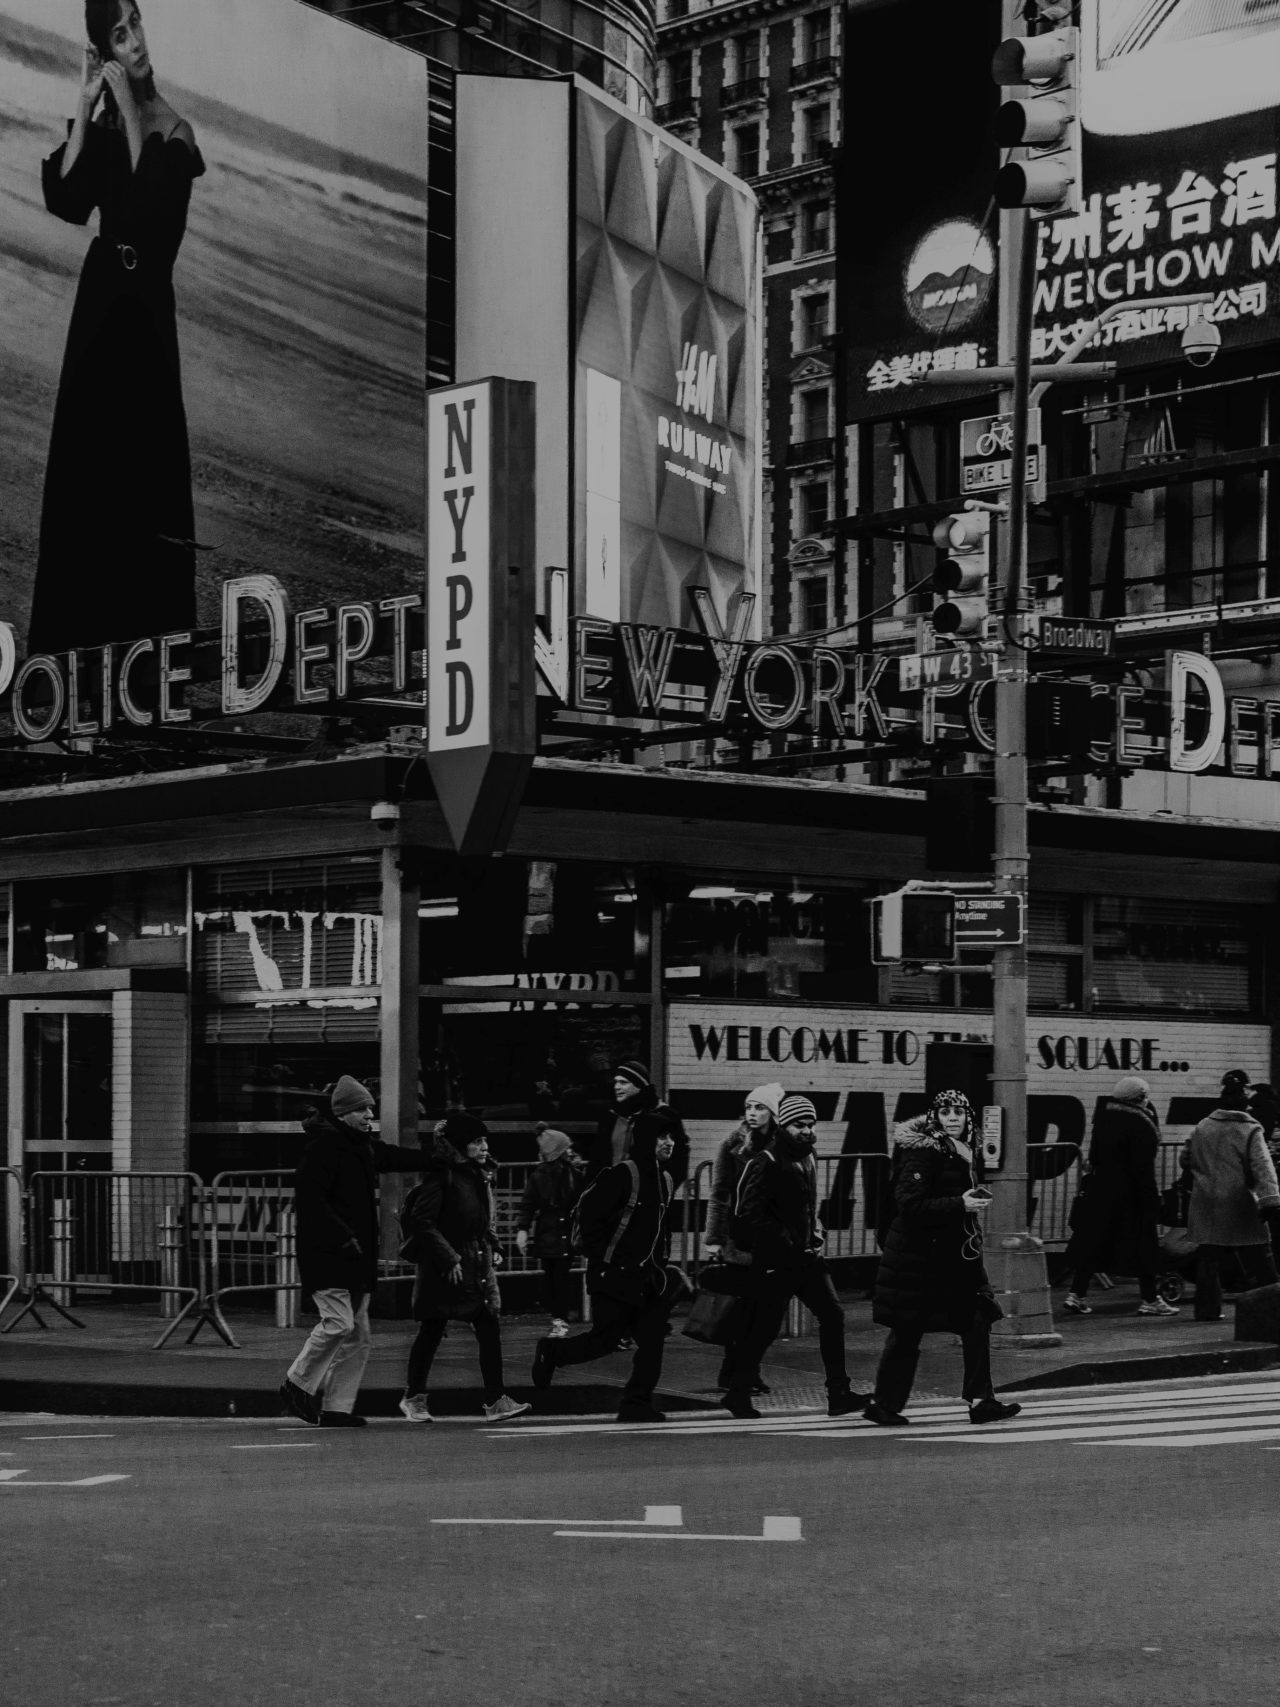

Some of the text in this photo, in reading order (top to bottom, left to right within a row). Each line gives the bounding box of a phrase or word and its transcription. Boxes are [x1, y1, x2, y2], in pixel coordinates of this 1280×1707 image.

[1033, 240, 1230, 314] WEICHOW
[657, 415, 732, 474] RUNWAY
[966, 457, 1038, 486] BIKE LE
[444, 399, 476, 737] NYPD
[1043, 622, 1112, 655] Broadway
[923, 656, 941, 683] W
[950, 653, 972, 679] 43
[1170, 649, 1280, 777] DE
[688, 1023, 869, 1065] WELCOME
[877, 1029, 919, 1066] TO
